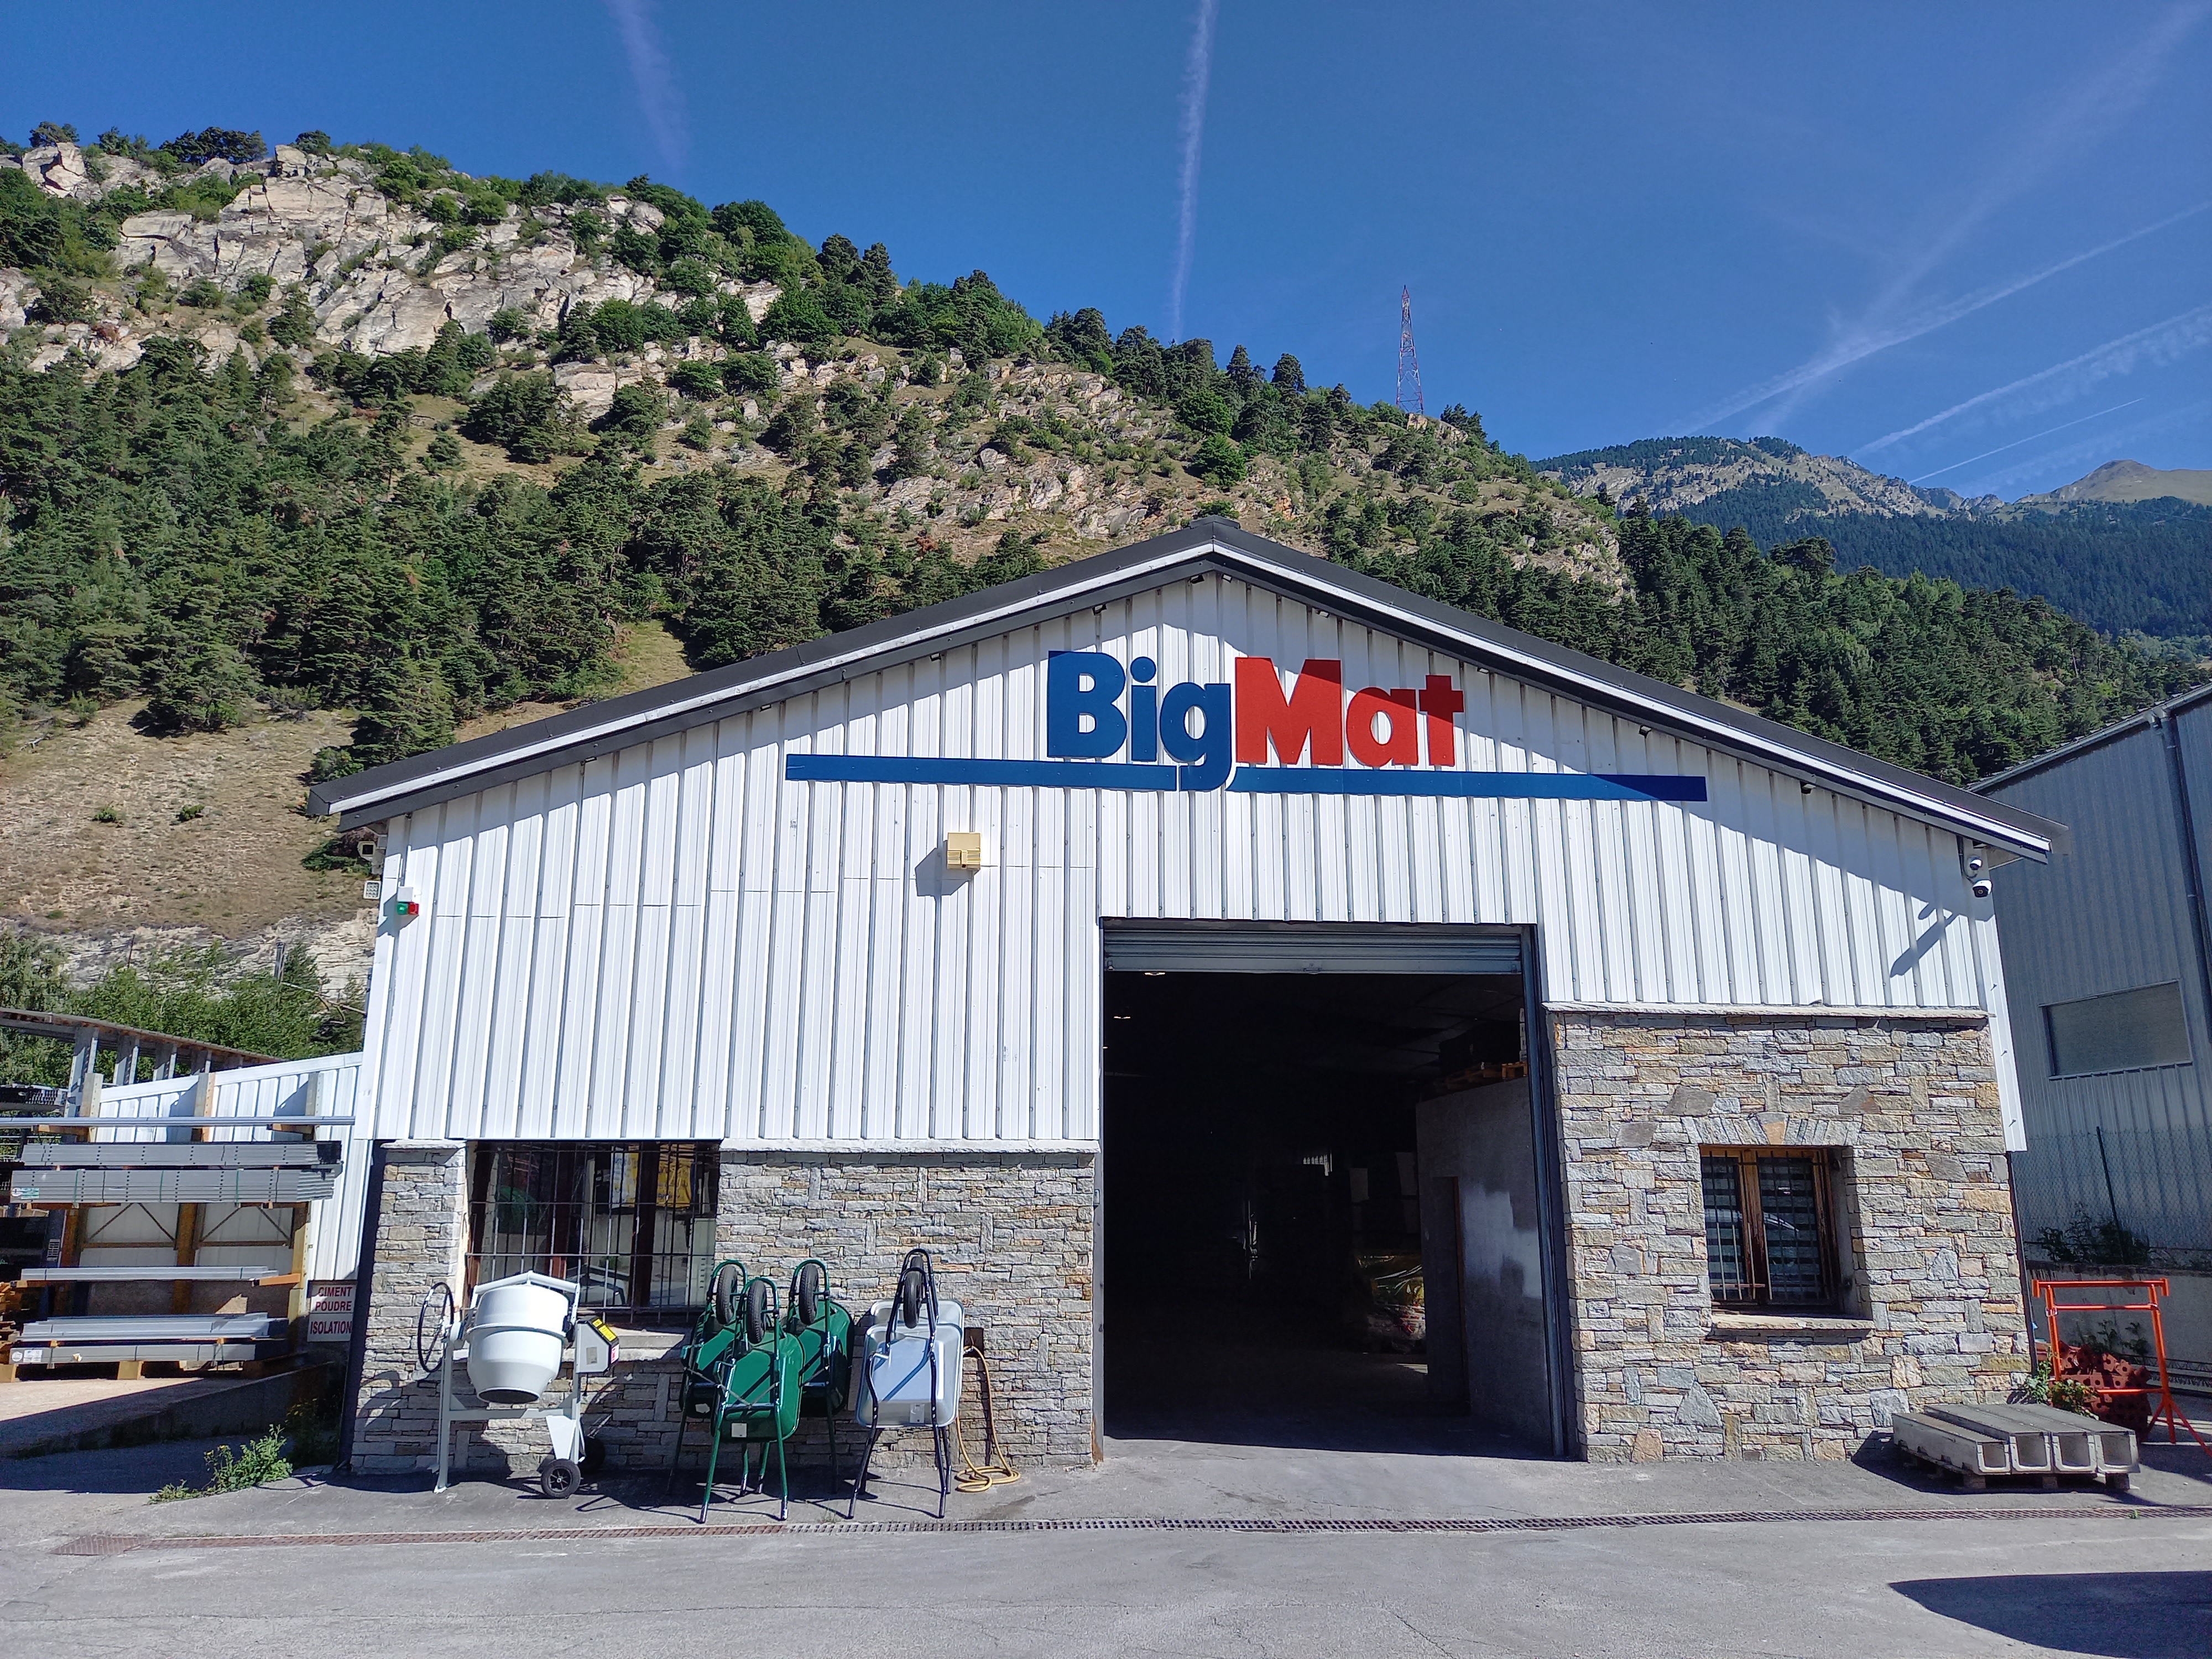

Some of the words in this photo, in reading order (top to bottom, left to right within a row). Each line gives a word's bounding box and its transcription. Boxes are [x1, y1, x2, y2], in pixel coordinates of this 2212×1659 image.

[1046, 650, 1464, 792] BigMat
[318, 1286, 353, 1297] CIMENT
[315, 1301, 352, 1311] POUDRE
[310, 1321, 352, 1334] ISOLATION
